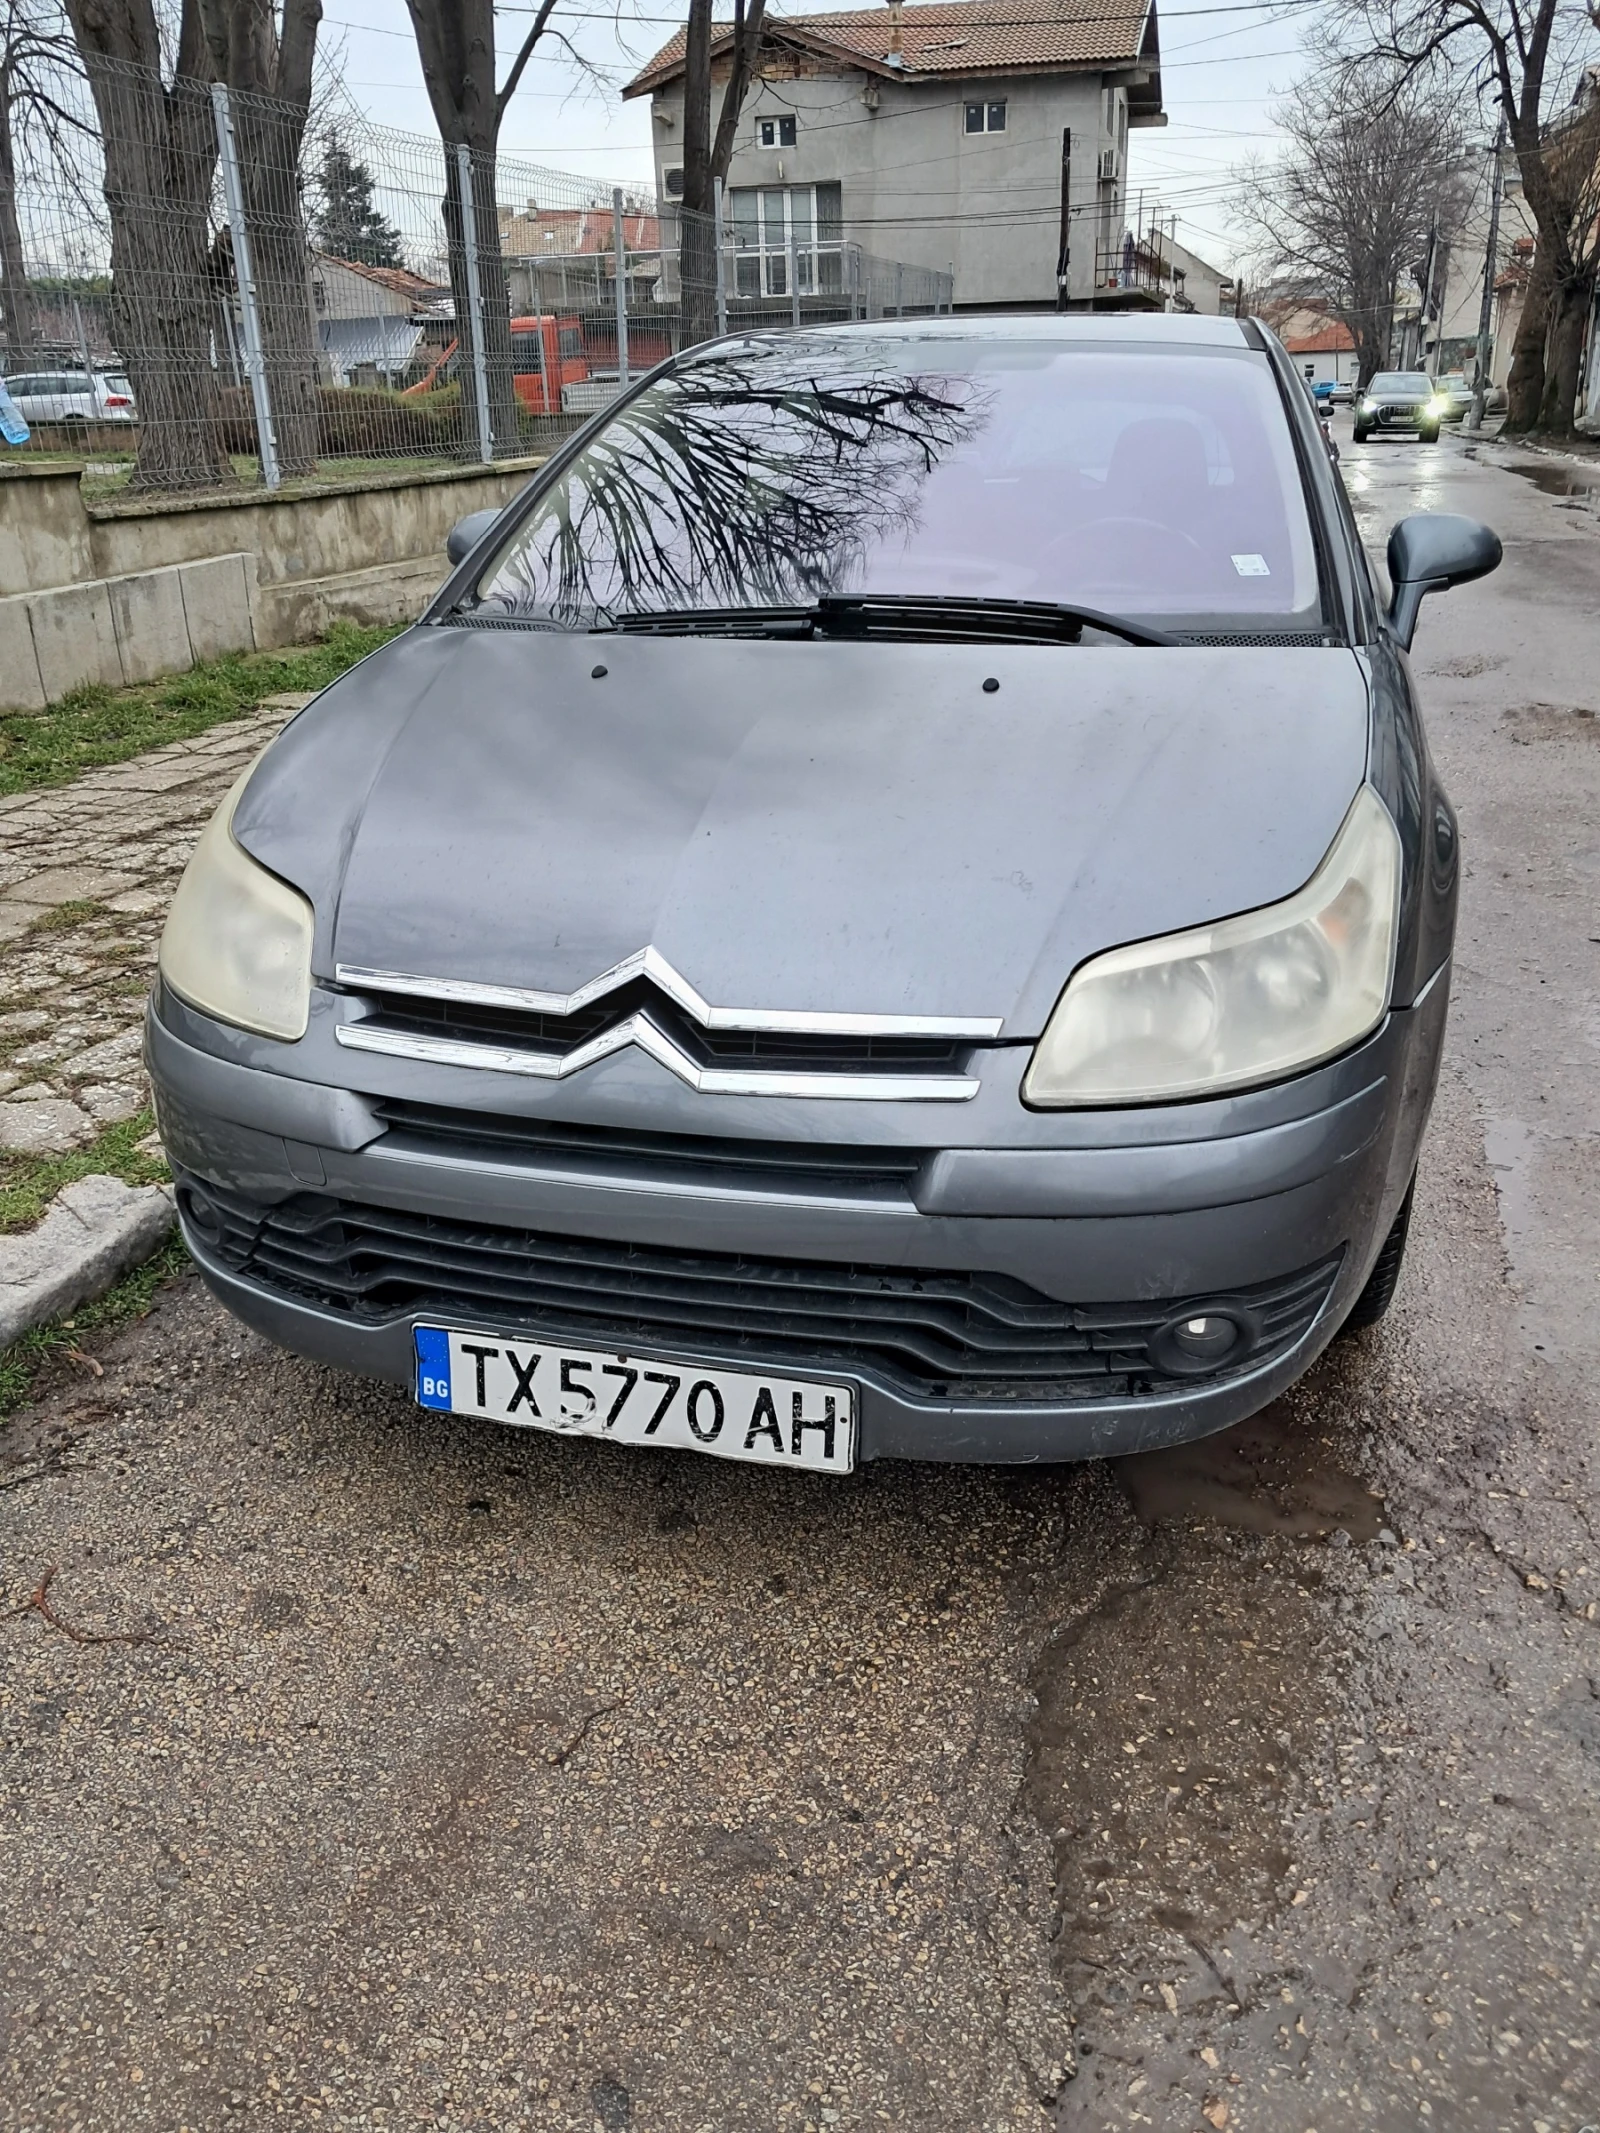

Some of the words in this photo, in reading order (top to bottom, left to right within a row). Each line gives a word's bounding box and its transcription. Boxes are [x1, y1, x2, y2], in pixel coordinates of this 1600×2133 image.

[423, 1377, 449, 1398] BG
[461, 1343, 543, 1417] TX
[559, 1357, 725, 1443] 5770
[742, 1387, 836, 1459] AH
